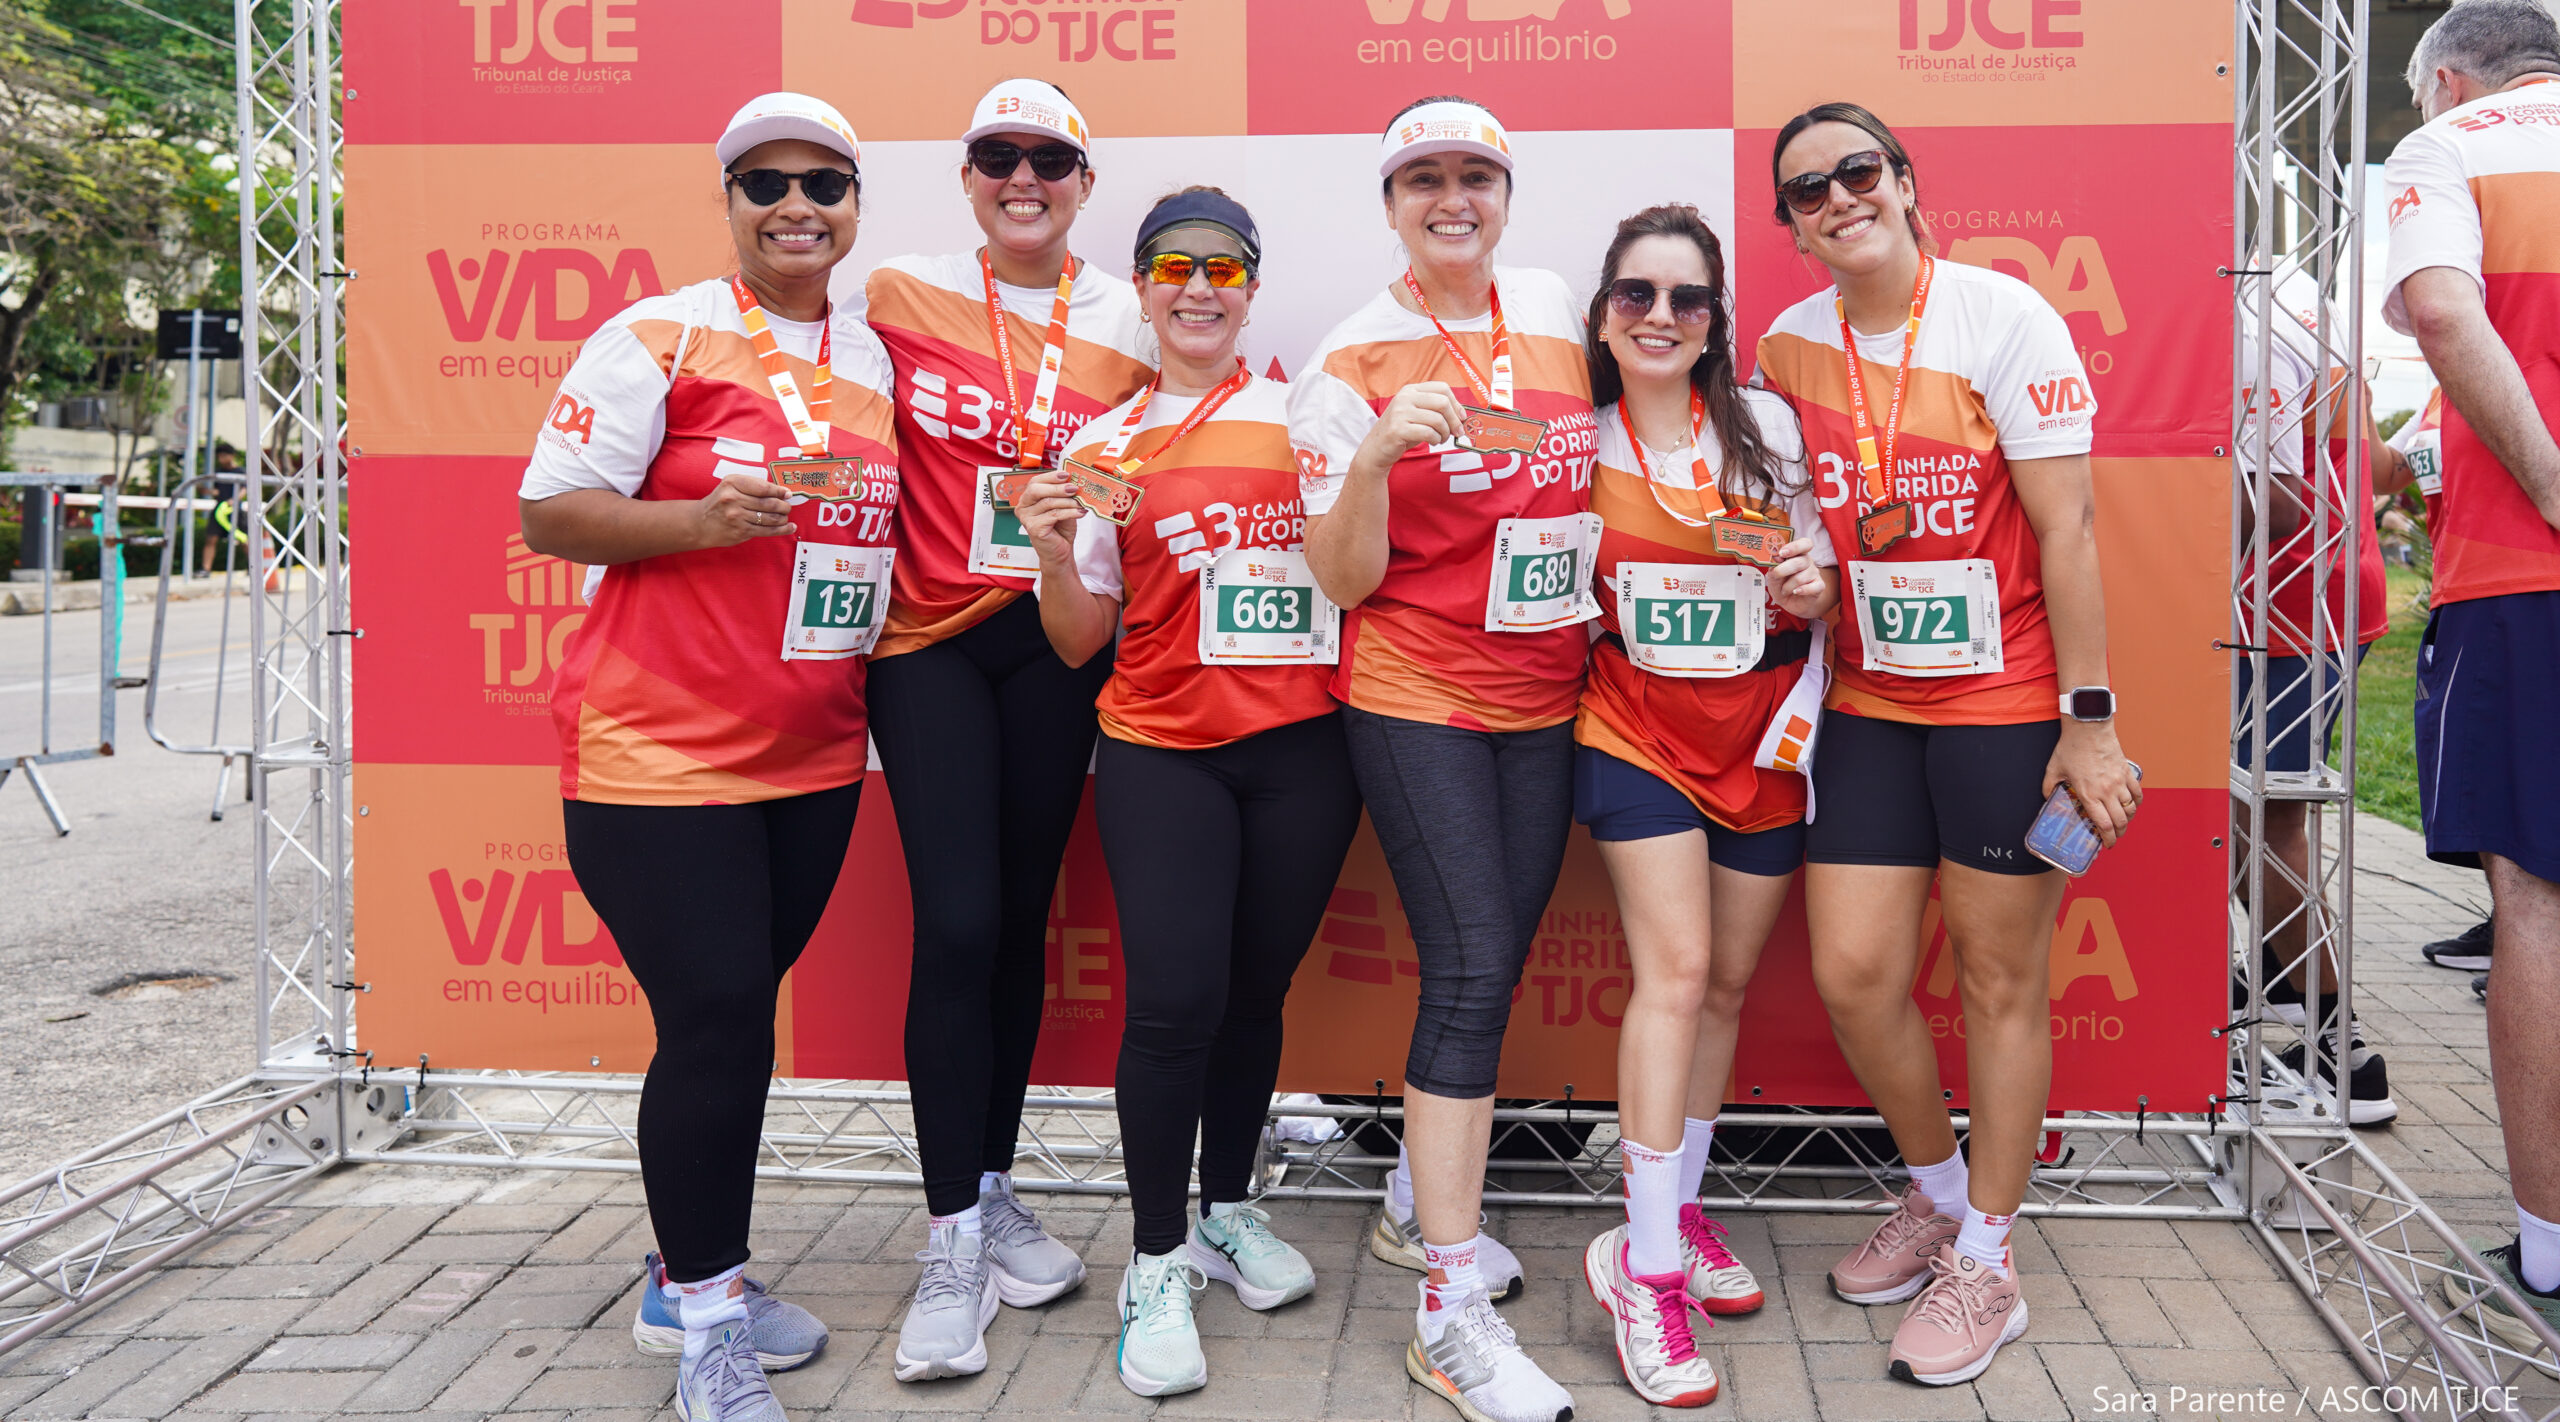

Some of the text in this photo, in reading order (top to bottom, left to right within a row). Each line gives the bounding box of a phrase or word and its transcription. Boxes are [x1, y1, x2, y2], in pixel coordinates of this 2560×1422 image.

[458, 0, 638, 64] TJCE
[981, 9, 1040, 45] DO
[1048, 10, 1176, 62] TJCE
[1356, 25, 1618, 74] em equilíbrio
[1898, 53, 2077, 73] Tribunal de Justiça
[472, 67, 632, 85] Tribunal de Justiça
[1922, 70, 2046, 83] do Estado do Ceará
[494, 82, 605, 95] do Estado do Ceará
[1926, 210, 2064, 229] ROGRAMA
[481, 223, 621, 241] PROGRAMA
[439, 346, 581, 388] em equi
[1851, 377, 1867, 429] DO TJCE 2026
[2038, 419, 2057, 431] em
[1529, 459, 1563, 489] DO
[1565, 454, 1598, 492] TJC
[1857, 453, 1982, 476] CINHADA
[1855, 472, 1980, 500] /CRRIDA
[1252, 499, 1306, 520] CAMI
[1909, 497, 1976, 539] JCE
[817, 501, 894, 543] DO TJC
[1246, 517, 1306, 545] /COR
[1500, 538, 1509, 561] 3KM
[797, 561, 807, 584] 3KM
[1206, 567, 1215, 591] 3KM
[1523, 553, 1571, 598] 689
[1623, 580, 1632, 603] 3KM
[1689, 588, 1706, 596] TJCE
[1858, 578, 1867, 601] 3KM
[1918, 586, 1935, 594] TJCE
[819, 583, 871, 625] 137
[1232, 588, 1300, 630] 663
[1649, 601, 1722, 642] 517
[1881, 599, 1956, 640] 972
[469, 613, 588, 687] TJC
[483, 689, 551, 704] Tribunal
[505, 706, 519, 716] do
[485, 842, 569, 861] PROGR
[428, 867, 625, 969] VID
[442, 970, 641, 1015] em equilíbr
[1531, 974, 1635, 1028] TJC
[1044, 1003, 1105, 1022] Justiça
[1456, 1255, 1476, 1267] TJC
